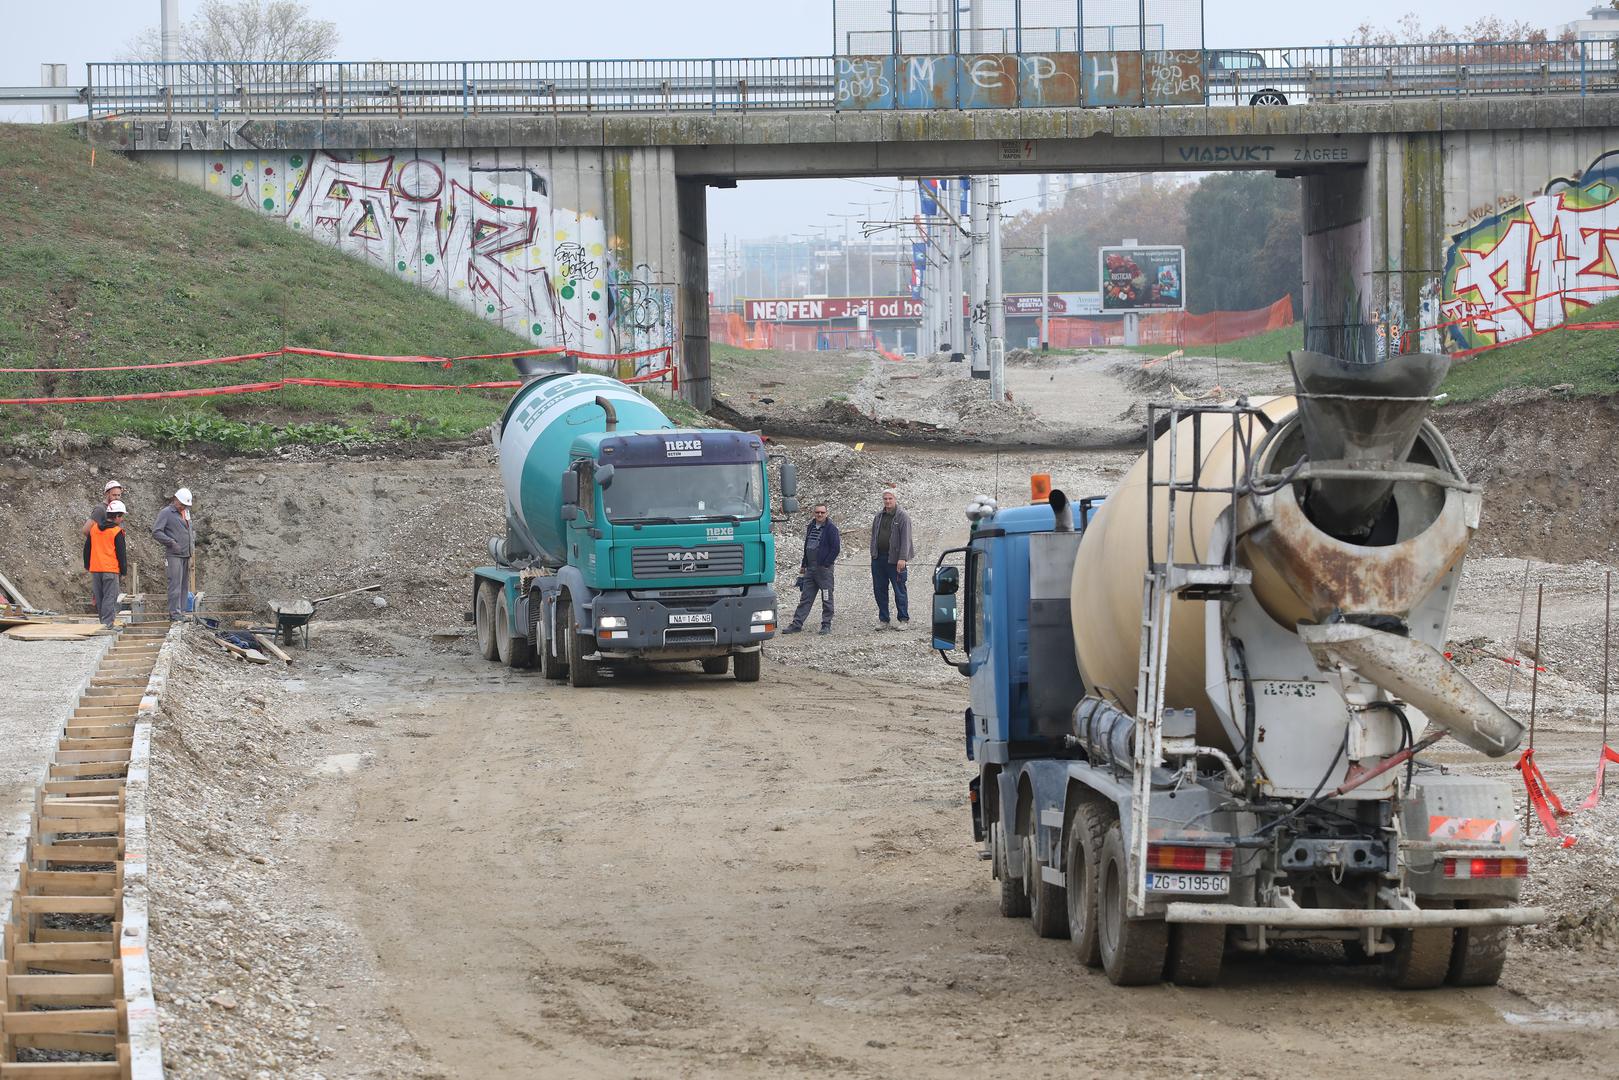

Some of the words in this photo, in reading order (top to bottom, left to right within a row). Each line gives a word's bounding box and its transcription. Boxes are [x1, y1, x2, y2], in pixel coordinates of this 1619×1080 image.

[1151, 65, 1182, 82] HOP
[1151, 75, 1201, 97] 4EVER
[1178, 146, 1275, 162] VIADUKT
[1294, 148, 1349, 161] ZAGREB
[879, 300, 898, 317] od
[664, 440, 702, 451] nexe
[706, 527, 734, 536] nexe
[667, 551, 709, 561] MAN
[1154, 875, 1170, 889] ZG
